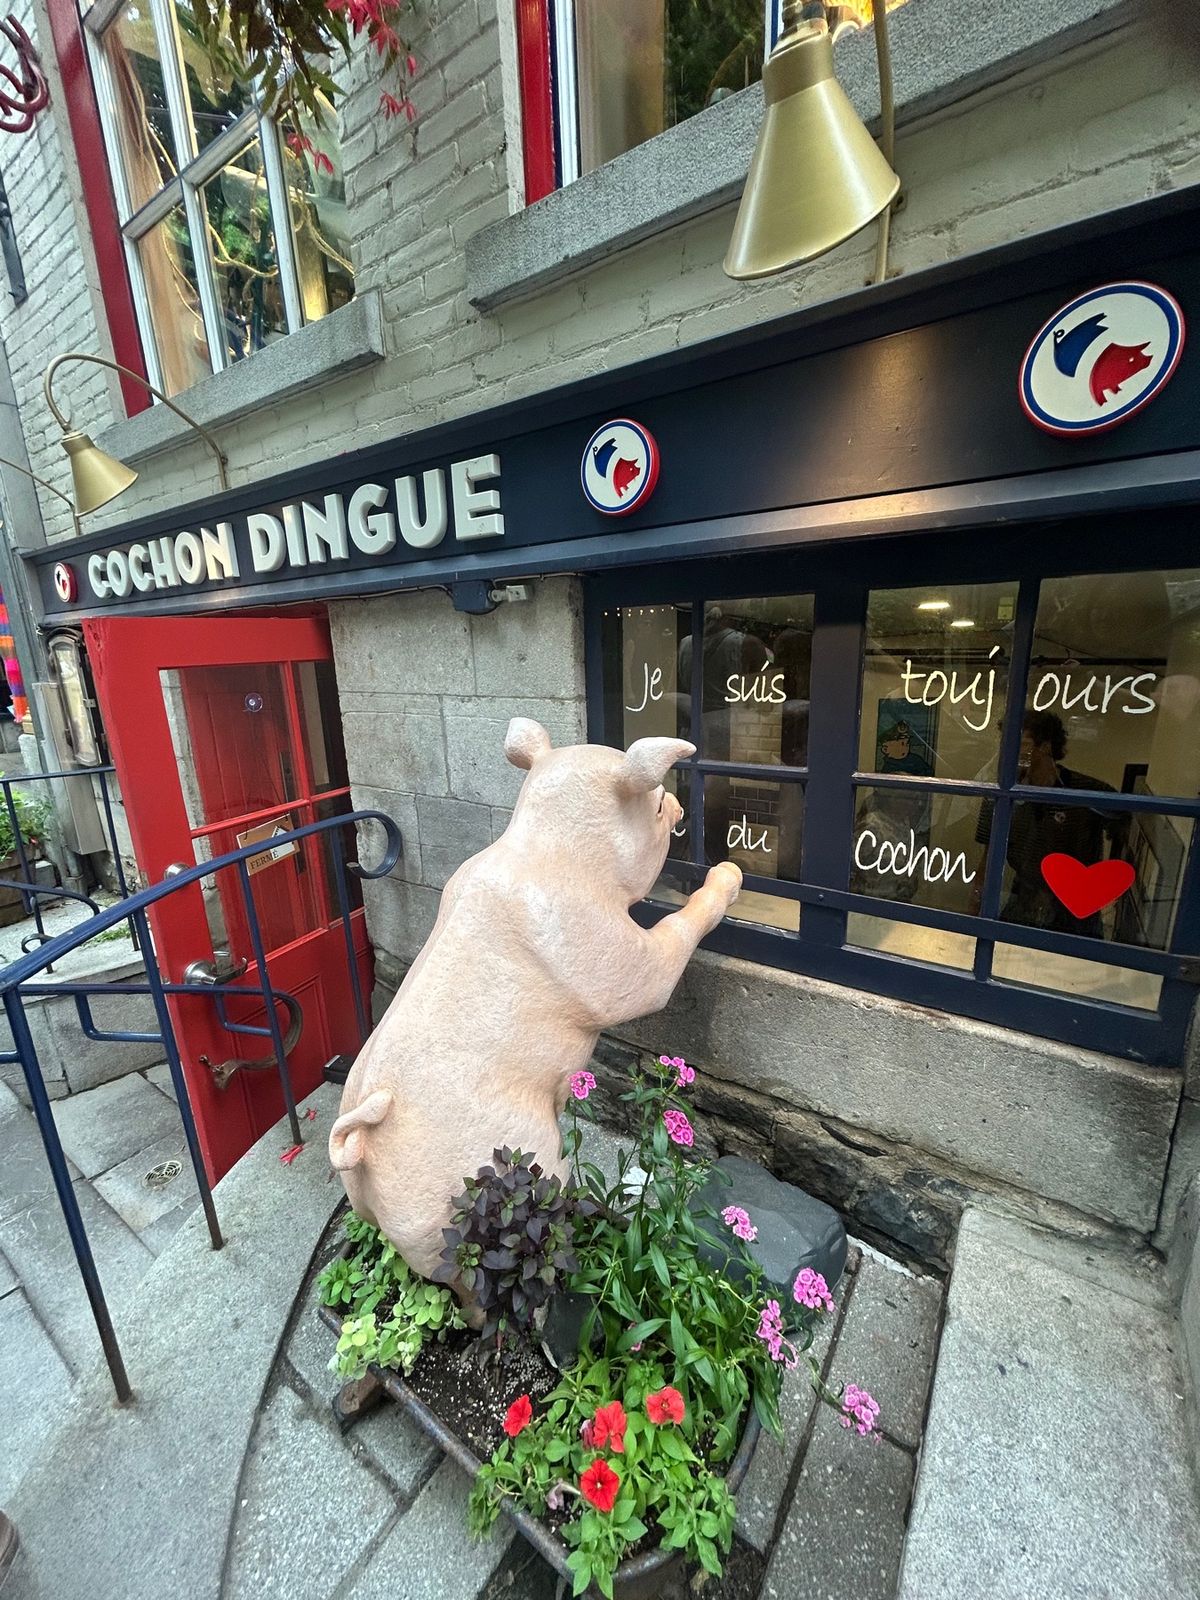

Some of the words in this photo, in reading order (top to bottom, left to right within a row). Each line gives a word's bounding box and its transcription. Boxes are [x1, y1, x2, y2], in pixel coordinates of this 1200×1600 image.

[88, 522, 240, 599] COCHON
[247, 453, 505, 573] DINGUE
[724, 660, 787, 703] suis
[726, 814, 772, 853] du
